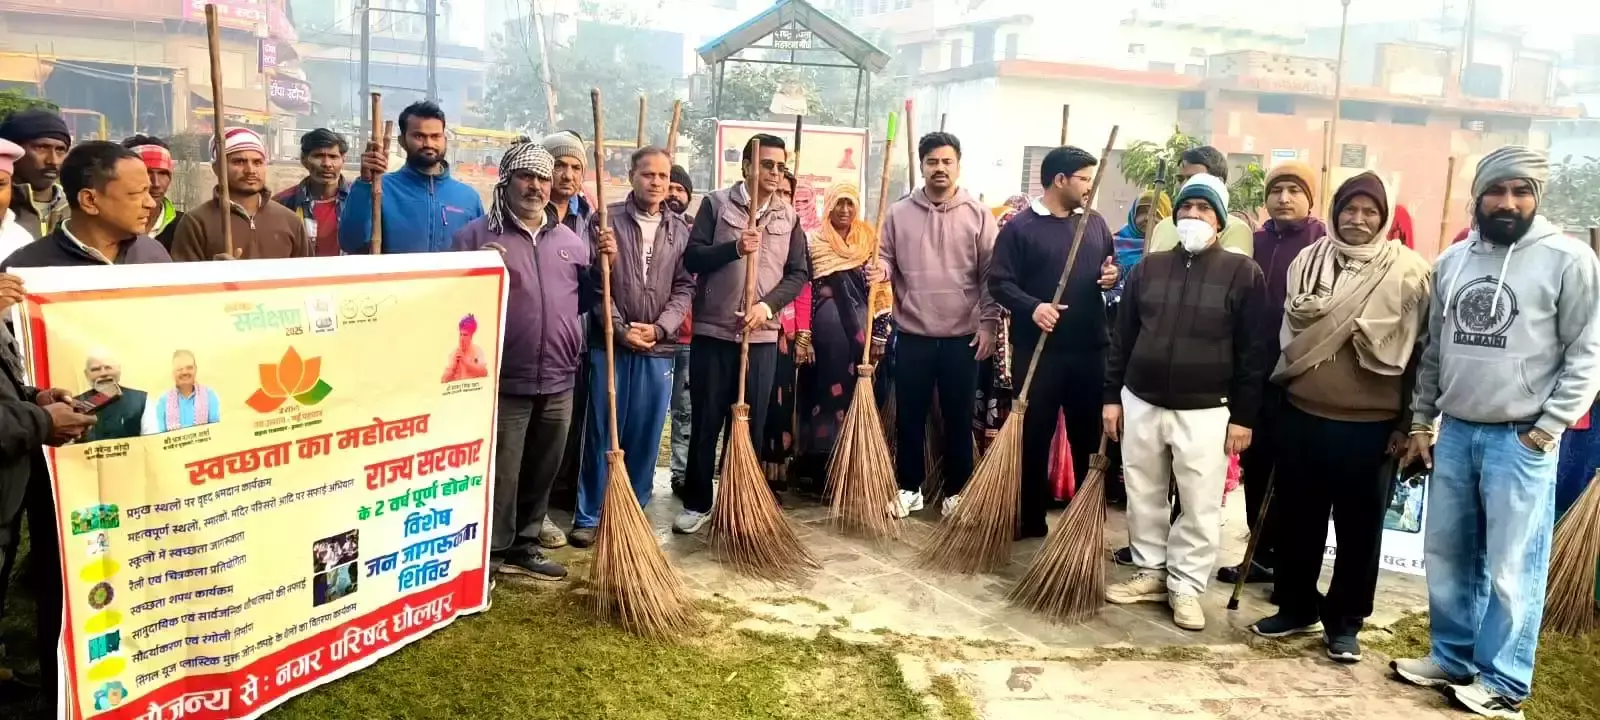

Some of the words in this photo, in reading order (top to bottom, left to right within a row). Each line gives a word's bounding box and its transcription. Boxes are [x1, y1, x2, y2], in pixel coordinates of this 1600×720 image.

[231, 303, 301, 333] सर्वेक्षण
[285, 327, 304, 336] 2025
[1454, 332, 1506, 348] BALMAIN
[184, 441, 292, 485] स्वच्छता
[295, 433, 334, 460] का
[336, 413, 431, 450] महोत्सव
[363, 453, 414, 491] राज्य
[416, 438, 484, 477] सरकार
[126, 504, 151, 519] प्रमुख
[184, 497, 196, 507] पर
[214, 484, 240, 499] श्रमदान
[241, 477, 272, 492] कार्यक्रम
[279, 492, 294, 506] आदि
[295, 491, 305, 502] पर
[306, 482, 327, 499] सफाई
[328, 479, 355, 493] अभियान
[357, 506, 372, 521] के
[375, 500, 385, 517] 2
[388, 488, 411, 512] वर्ष
[411, 480, 438, 508] पूर्ण
[441, 475, 470, 497] होने
[404, 508, 453, 538] विशेष
[169, 543, 208, 557] स्वच्छता
[364, 551, 399, 578] जन
[128, 575, 145, 592] रैली
[147, 572, 162, 586] एवं
[165, 569, 208, 583] चित्रकला
[209, 554, 247, 574] प्रतियोगिता
[398, 559, 452, 593] शिविर
[130, 598, 165, 616] स्वच्छता
[169, 591, 193, 605] शपथ
[132, 617, 180, 640] सामुदायिक
[198, 604, 243, 620] सार्वजनिक
[276, 585, 286, 599] की
[162, 663, 177, 679] यूज
[179, 656, 221, 669] प्लास्टिक
[299, 621, 308, 633] का
[309, 613, 333, 630] वितरण
[202, 629, 232, 645] रंगोली
[233, 622, 255, 640] निर्माण
[275, 646, 326, 687] नगर
[330, 617, 390, 661] परिषद
